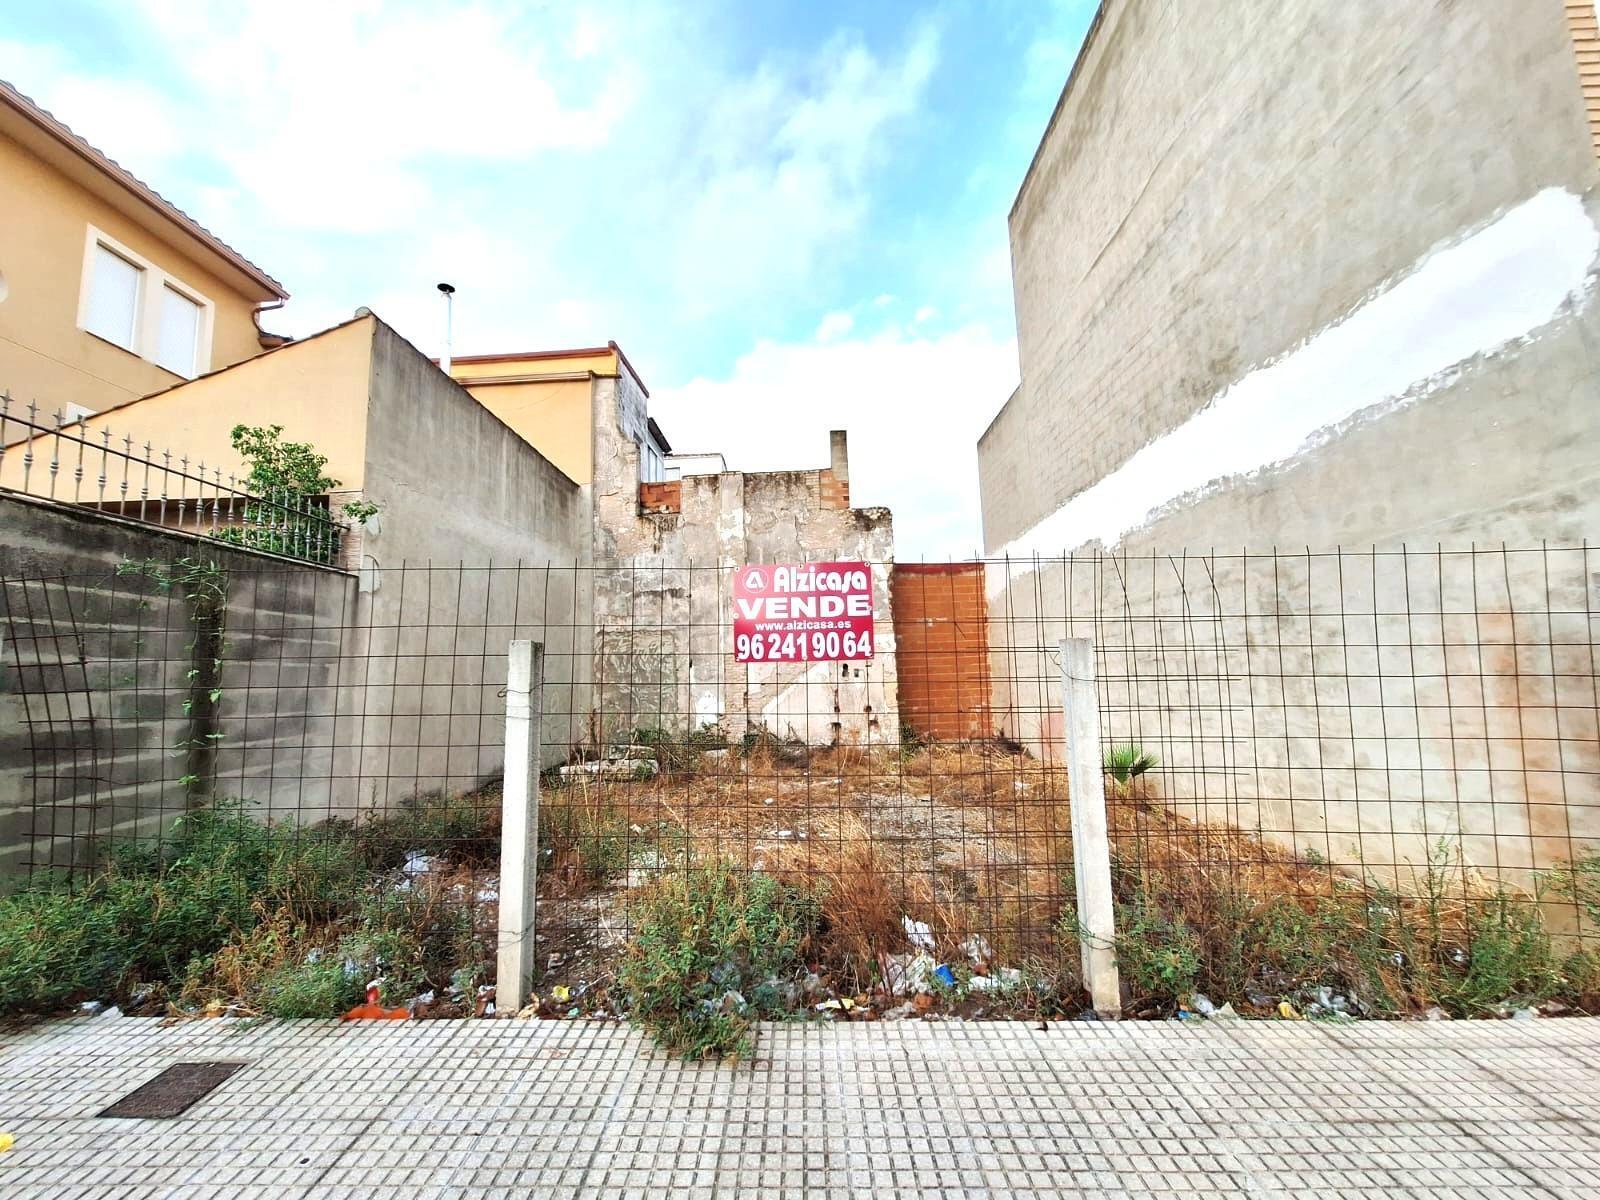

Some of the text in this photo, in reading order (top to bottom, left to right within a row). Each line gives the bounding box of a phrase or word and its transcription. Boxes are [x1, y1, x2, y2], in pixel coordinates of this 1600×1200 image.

[774, 566, 867, 593] Alzicasa
[737, 595, 871, 620] VENDE
[755, 620, 852, 631] www.alzicasa.es
[737, 633, 764, 660] 96
